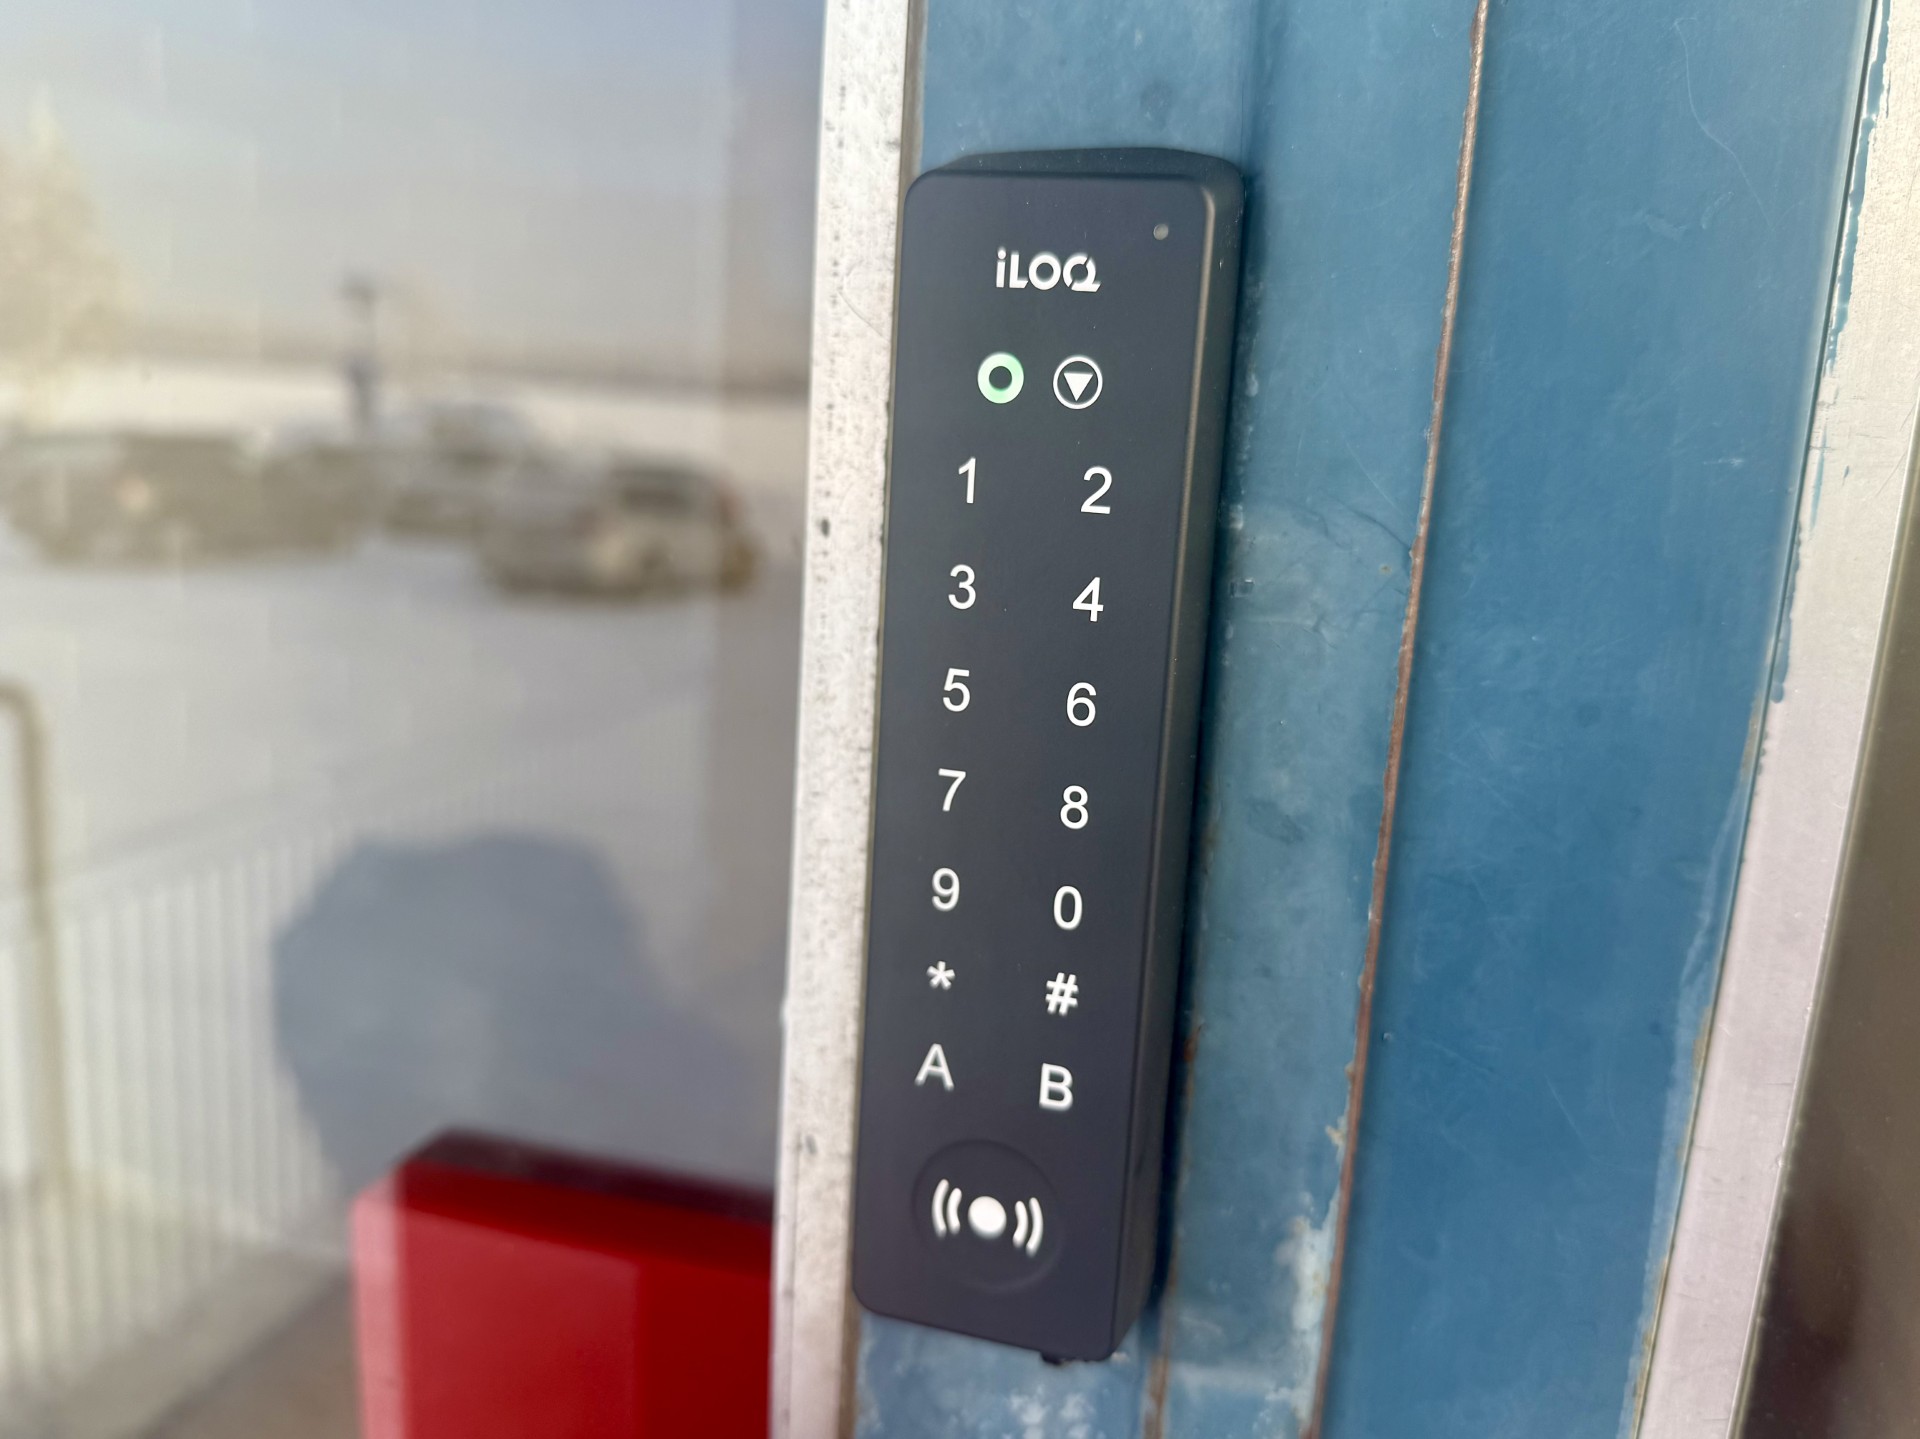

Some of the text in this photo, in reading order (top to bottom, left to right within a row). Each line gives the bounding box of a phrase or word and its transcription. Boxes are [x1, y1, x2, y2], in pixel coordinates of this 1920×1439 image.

[995, 246, 1101, 293] iLOQ
[958, 456, 1113, 515] 1 2
[947, 563, 1105, 623] 3 4
[942, 667, 1097, 727] 5 6
[937, 767, 1089, 830] 7 8
[931, 867, 1083, 931] 9 0
[1045, 972, 1079, 1016] #
[915, 1043, 1073, 1111] A B
